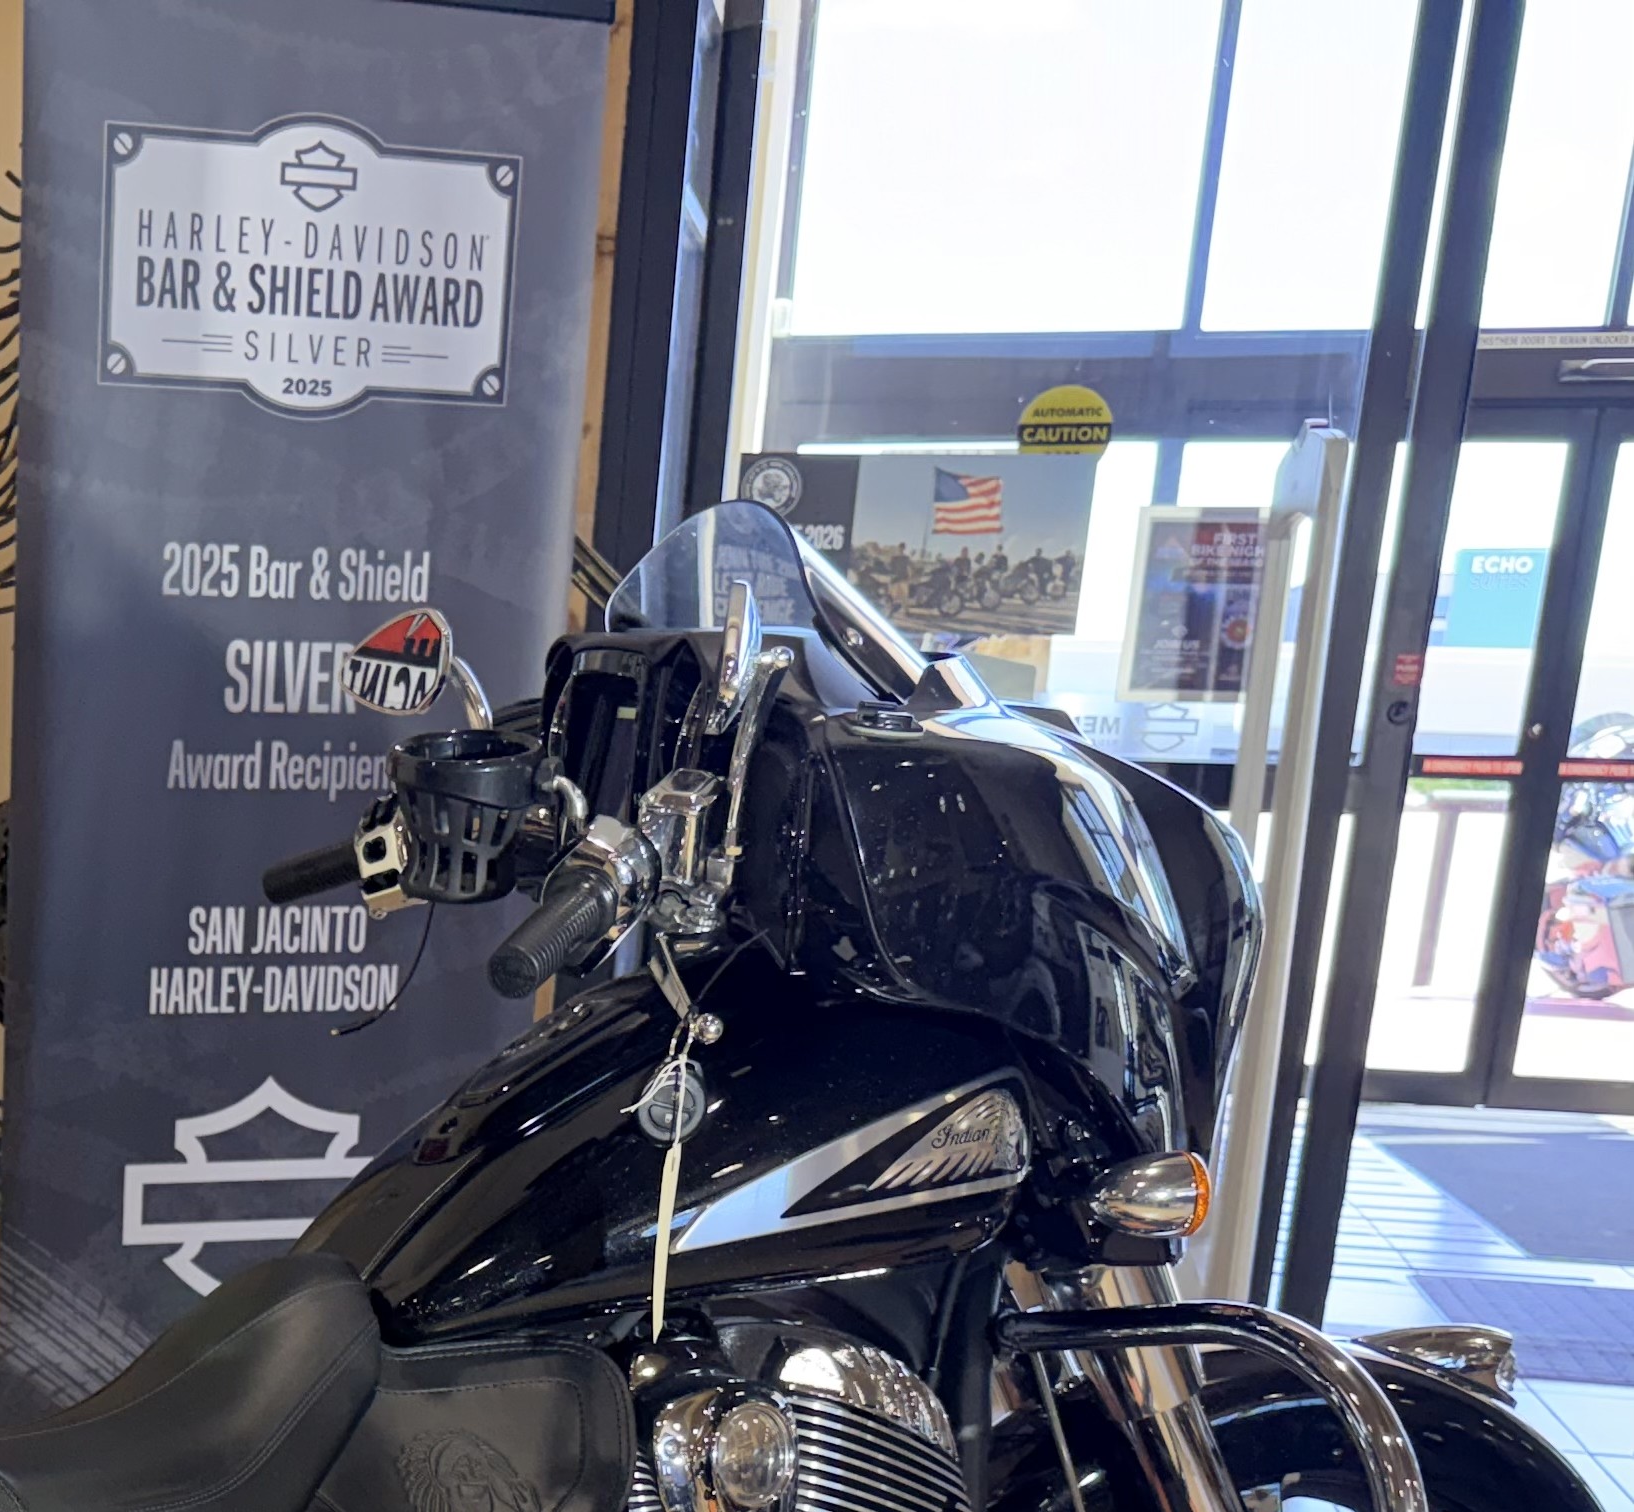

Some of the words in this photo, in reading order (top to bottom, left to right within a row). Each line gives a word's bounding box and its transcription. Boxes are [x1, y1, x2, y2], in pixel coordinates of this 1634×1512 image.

[135, 255, 201, 311] BAR
[212, 260, 236, 313] &
[247, 263, 362, 321] SHIELD
[369, 272, 483, 328] AWARD
[244, 330, 372, 368] SILVER
[282, 378, 333, 396] 2025
[1033, 407, 1104, 418] AUTOMATIC
[1023, 426, 1108, 443] CAUTION
[805, 524, 845, 551] 2026
[1227, 545, 1263, 557] NIGH
[162, 542, 240, 598] 2025
[248, 545, 303, 599] Bar
[309, 547, 331, 601] &
[338, 548, 430, 603] Shield
[1471, 555, 1534, 574] ECHO
[224, 639, 357, 714] SILVER
[167, 739, 262, 790] Award
[269, 740, 391, 802] Recipien
[188, 905, 245, 955] SAN
[251, 905, 367, 955] JACINTO
[149, 963, 399, 1015] HARLEY-DAVIDSON
[931, 1123, 990, 1149] Indian
